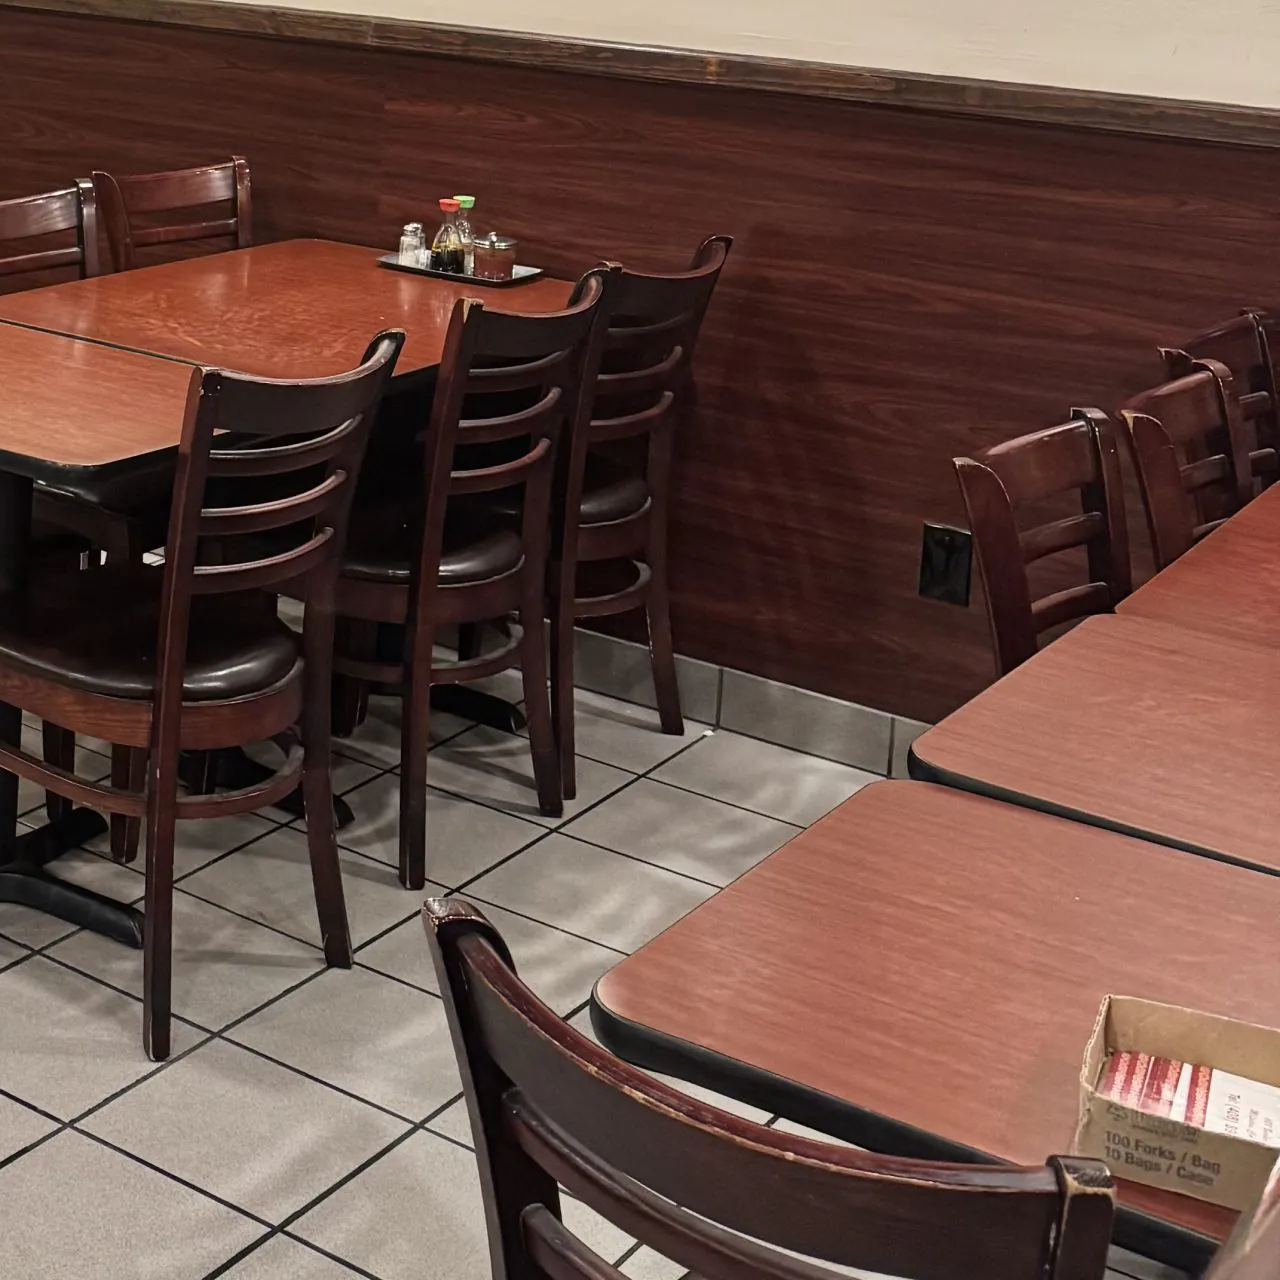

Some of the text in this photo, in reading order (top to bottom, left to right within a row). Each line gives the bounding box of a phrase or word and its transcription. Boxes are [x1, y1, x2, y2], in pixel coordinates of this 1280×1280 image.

[1105, 1146, 1214, 1186] 10 Bags / Case
[1106, 1131, 1221, 1176] 100 Forks / Bag
